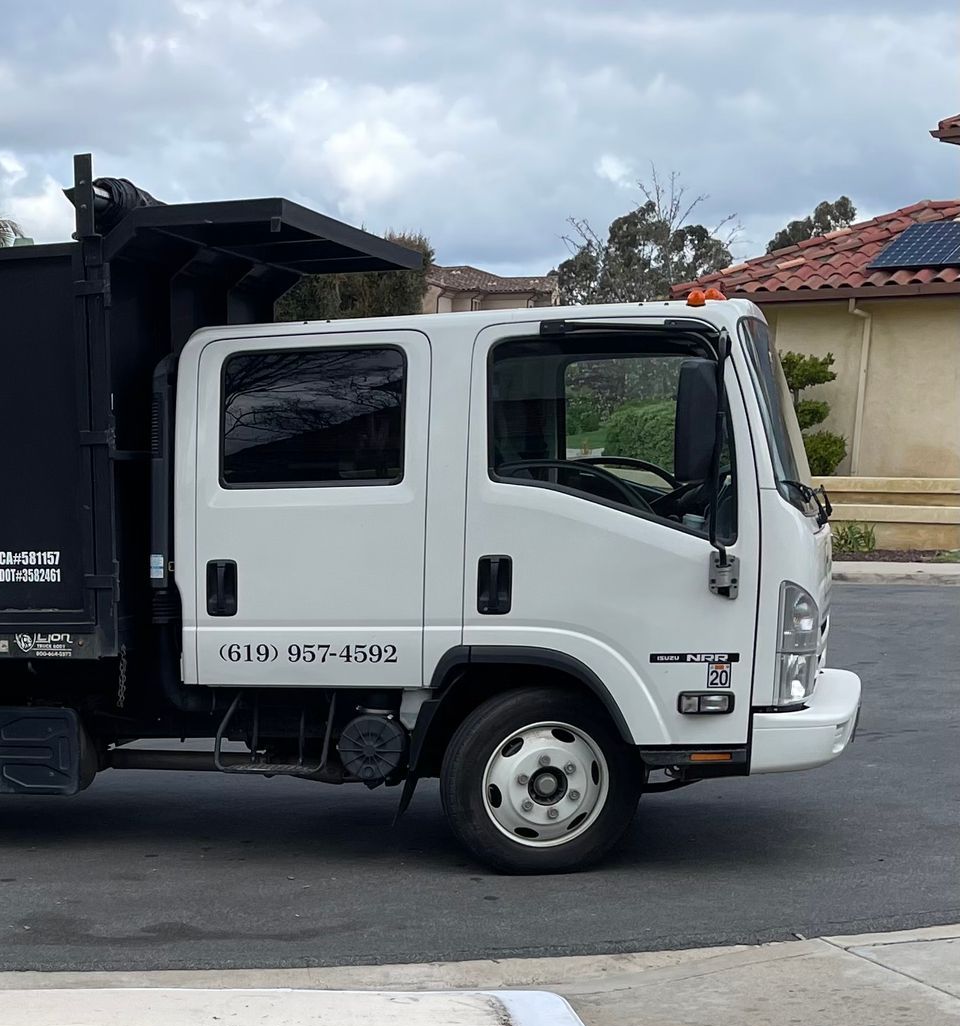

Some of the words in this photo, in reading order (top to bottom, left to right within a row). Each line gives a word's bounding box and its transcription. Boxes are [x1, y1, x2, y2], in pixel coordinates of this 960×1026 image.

[219, 643, 279, 663] (619)
[287, 643, 398, 663] 957-4592
[686, 654, 729, 662] NRR
[709, 669, 729, 686] 20
